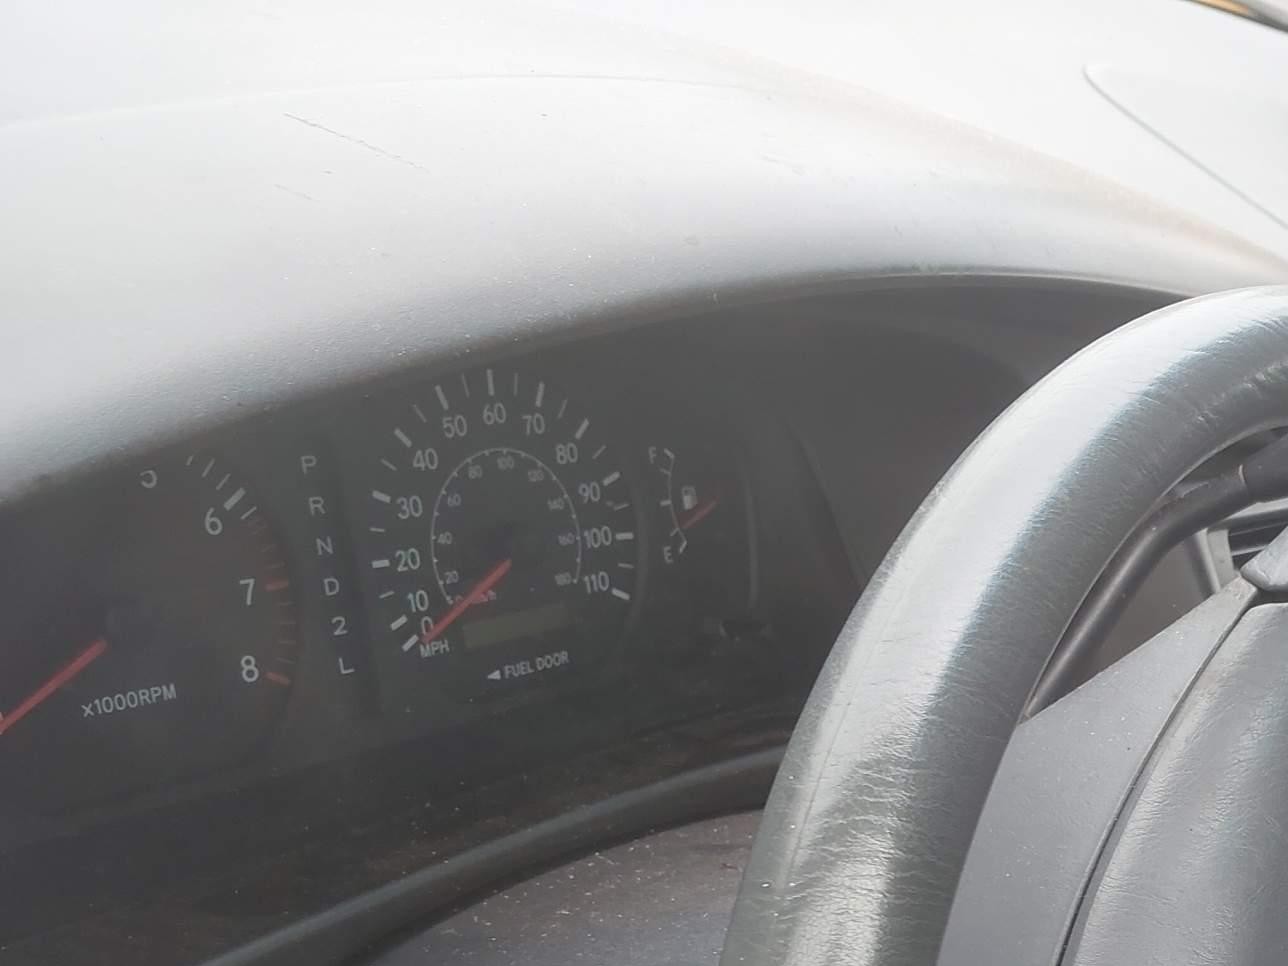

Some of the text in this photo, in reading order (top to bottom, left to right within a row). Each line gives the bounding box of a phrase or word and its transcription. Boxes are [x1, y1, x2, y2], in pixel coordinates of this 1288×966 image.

[483, 403, 506, 425] 60
[523, 413, 545, 435] 70
[443, 415, 467, 438] 50
[301, 455, 317, 473] P
[413, 448, 438, 471] 40
[555, 443, 578, 464] 80
[579, 481, 600, 503] 90
[309, 497, 325, 516] R
[397, 495, 422, 519] 30
[205, 508, 222, 535] 6
[316, 537, 334, 556] N
[584, 526, 612, 549] 100
[395, 548, 421, 571] 20
[664, 545, 673, 563] E
[324, 578, 340, 596] D
[444, 570, 459, 584] 20
[585, 571, 610, 594] 110
[240, 578, 256, 606] 7
[408, 590, 429, 613] 10
[332, 617, 348, 636] 2
[420, 640, 449, 658] MPH
[241, 656, 259, 683] 8
[338, 658, 355, 675] L
[504, 651, 569, 679] FUEL DOOR
[81, 684, 177, 719] x1000RPM
